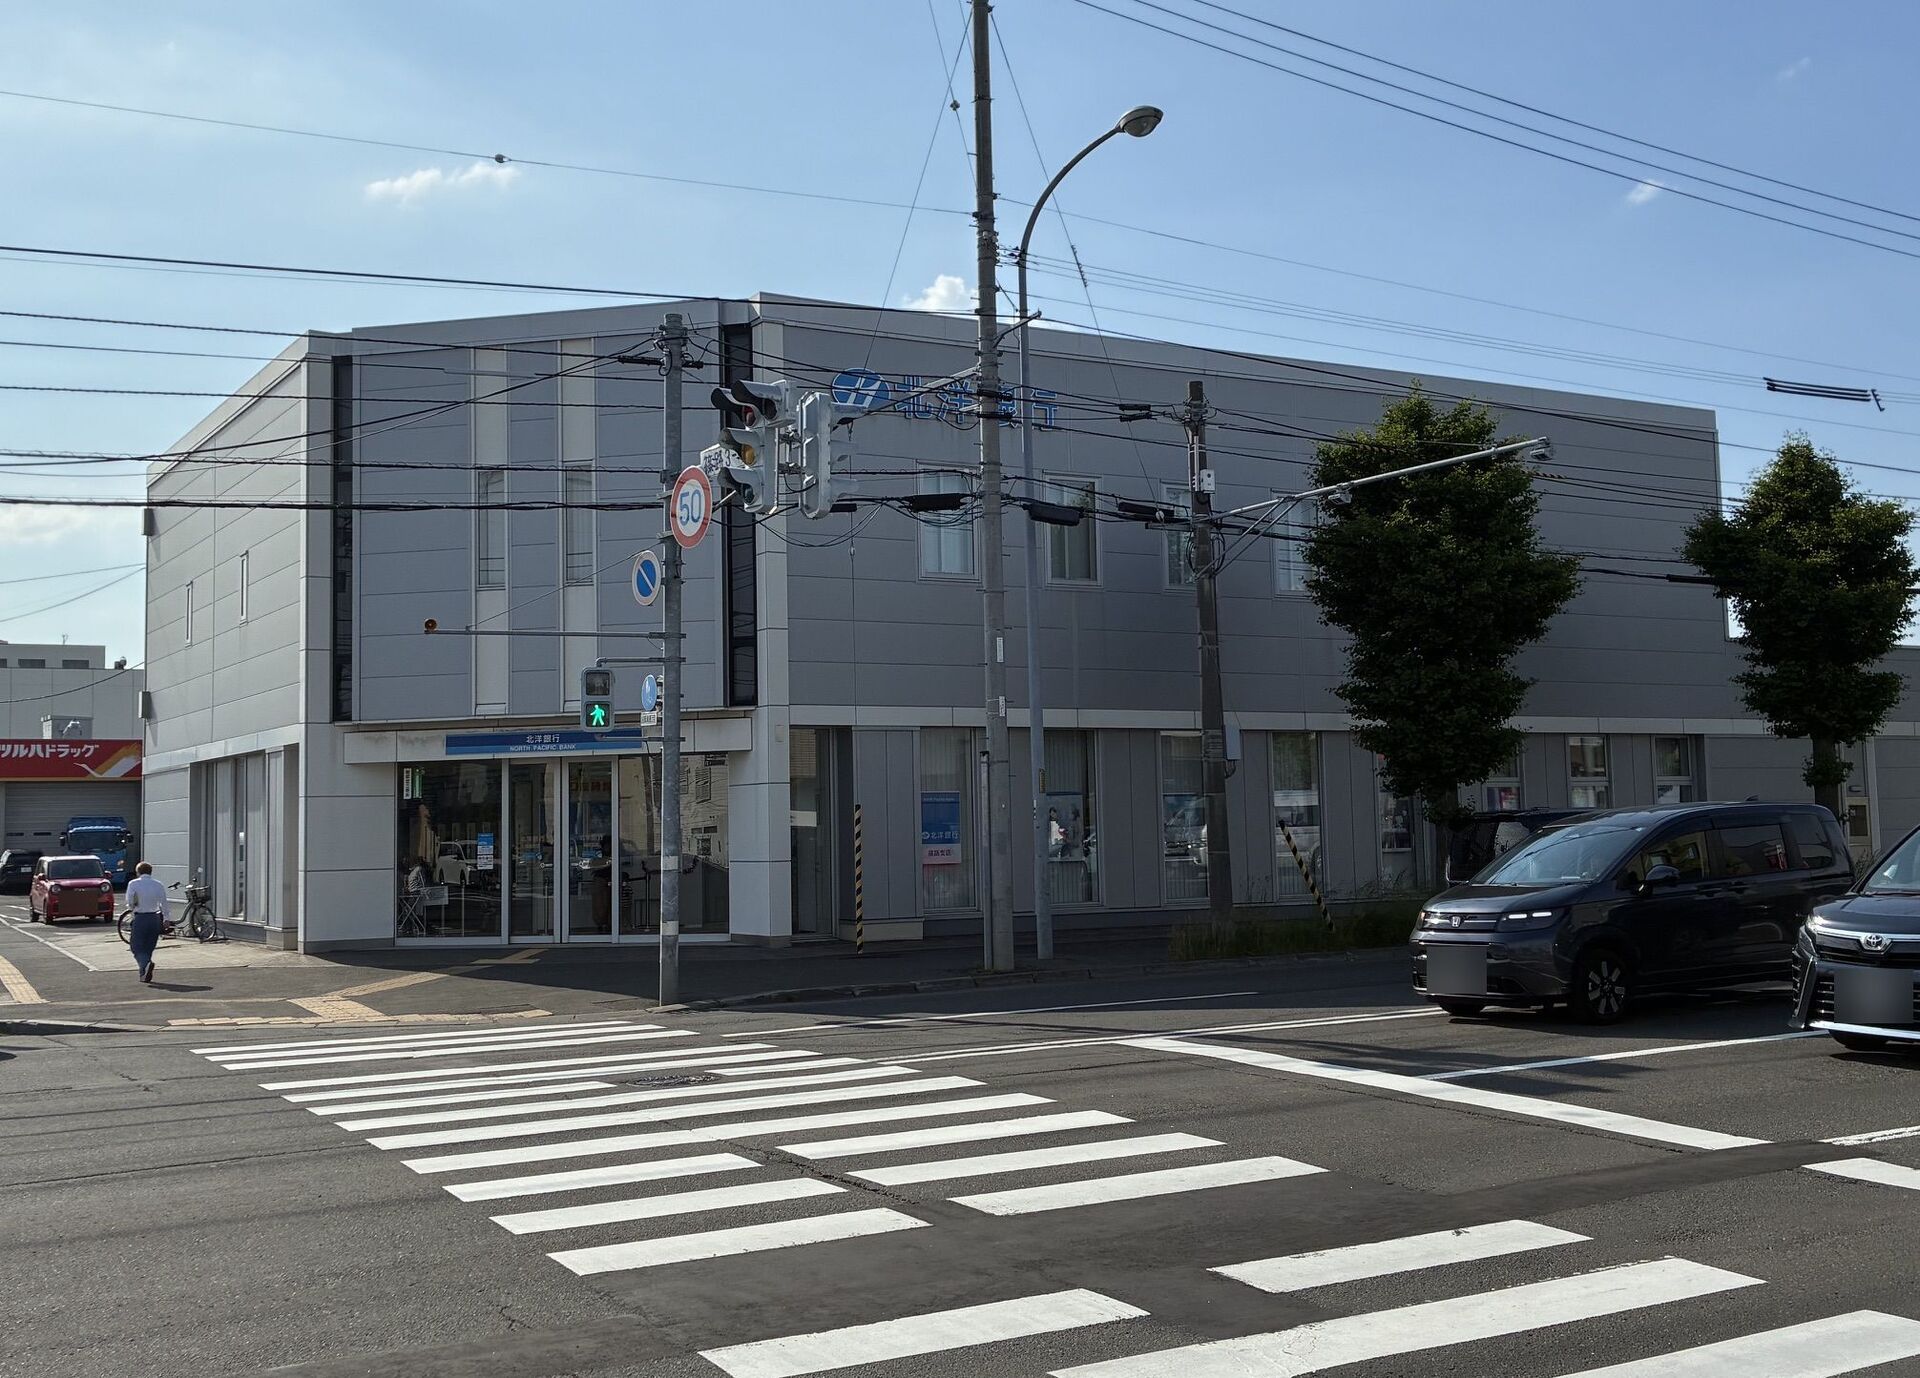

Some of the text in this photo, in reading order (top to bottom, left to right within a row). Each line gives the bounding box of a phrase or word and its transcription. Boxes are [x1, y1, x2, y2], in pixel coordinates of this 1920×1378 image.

[679, 489, 702, 527] 50
[525, 734, 560, 744] 北洋銀行
[0, 744, 99, 758] ツルハドラッグ
